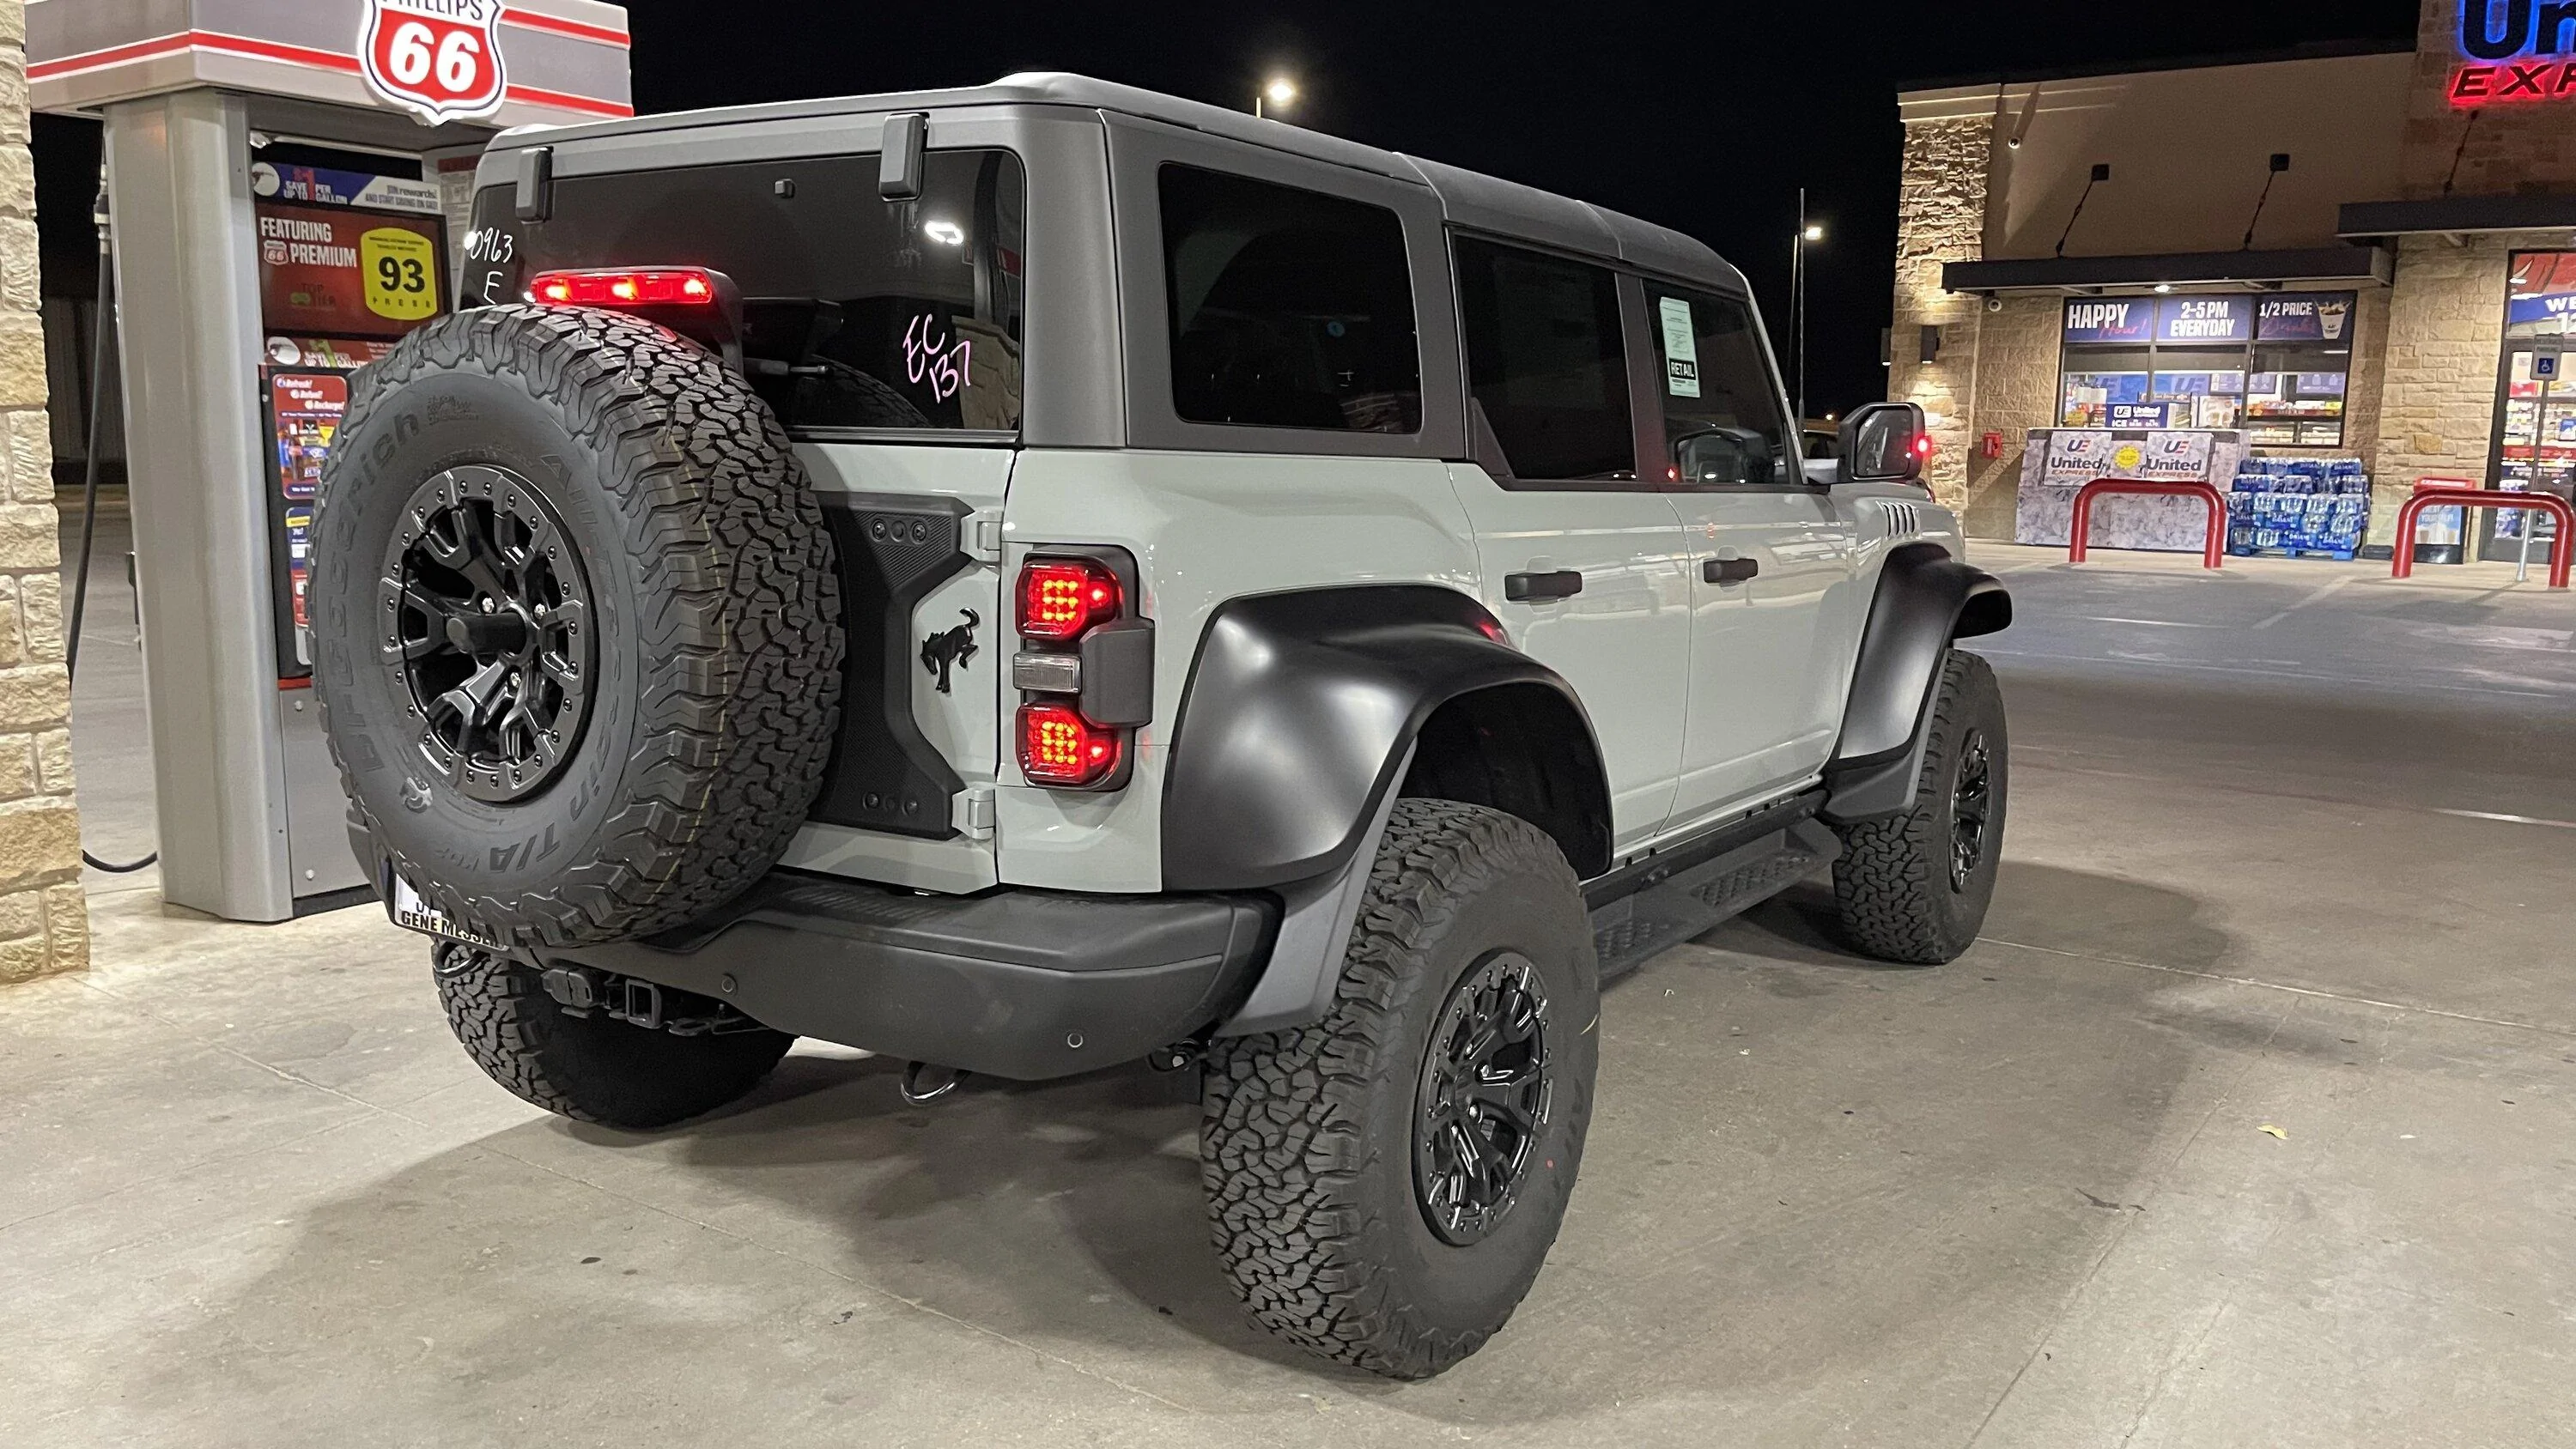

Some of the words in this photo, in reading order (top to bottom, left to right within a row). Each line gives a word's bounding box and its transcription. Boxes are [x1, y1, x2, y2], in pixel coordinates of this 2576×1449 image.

[389, 21, 480, 93] 66
[260, 217, 332, 243] FEATURING
[290, 243, 357, 268] PREMIUM
[379, 257, 425, 293] 93
[2068, 304, 2129, 329] HAPPY
[2180, 301, 2206, 318] 2-5
[2207, 300, 2229, 318] PM
[2259, 300, 2280, 318] 1/2
[2281, 302, 2312, 317] PRICE
[2170, 318, 2235, 337] EVERYDAY
[1670, 361, 1696, 378] RETAIL
[2067, 439, 2091, 453] UE
[2163, 440, 2190, 454] UE
[2050, 457, 2103, 470] United
[2148, 458, 2202, 471] United
[489, 820, 561, 874] T/A
[401, 911, 438, 931] GENE
